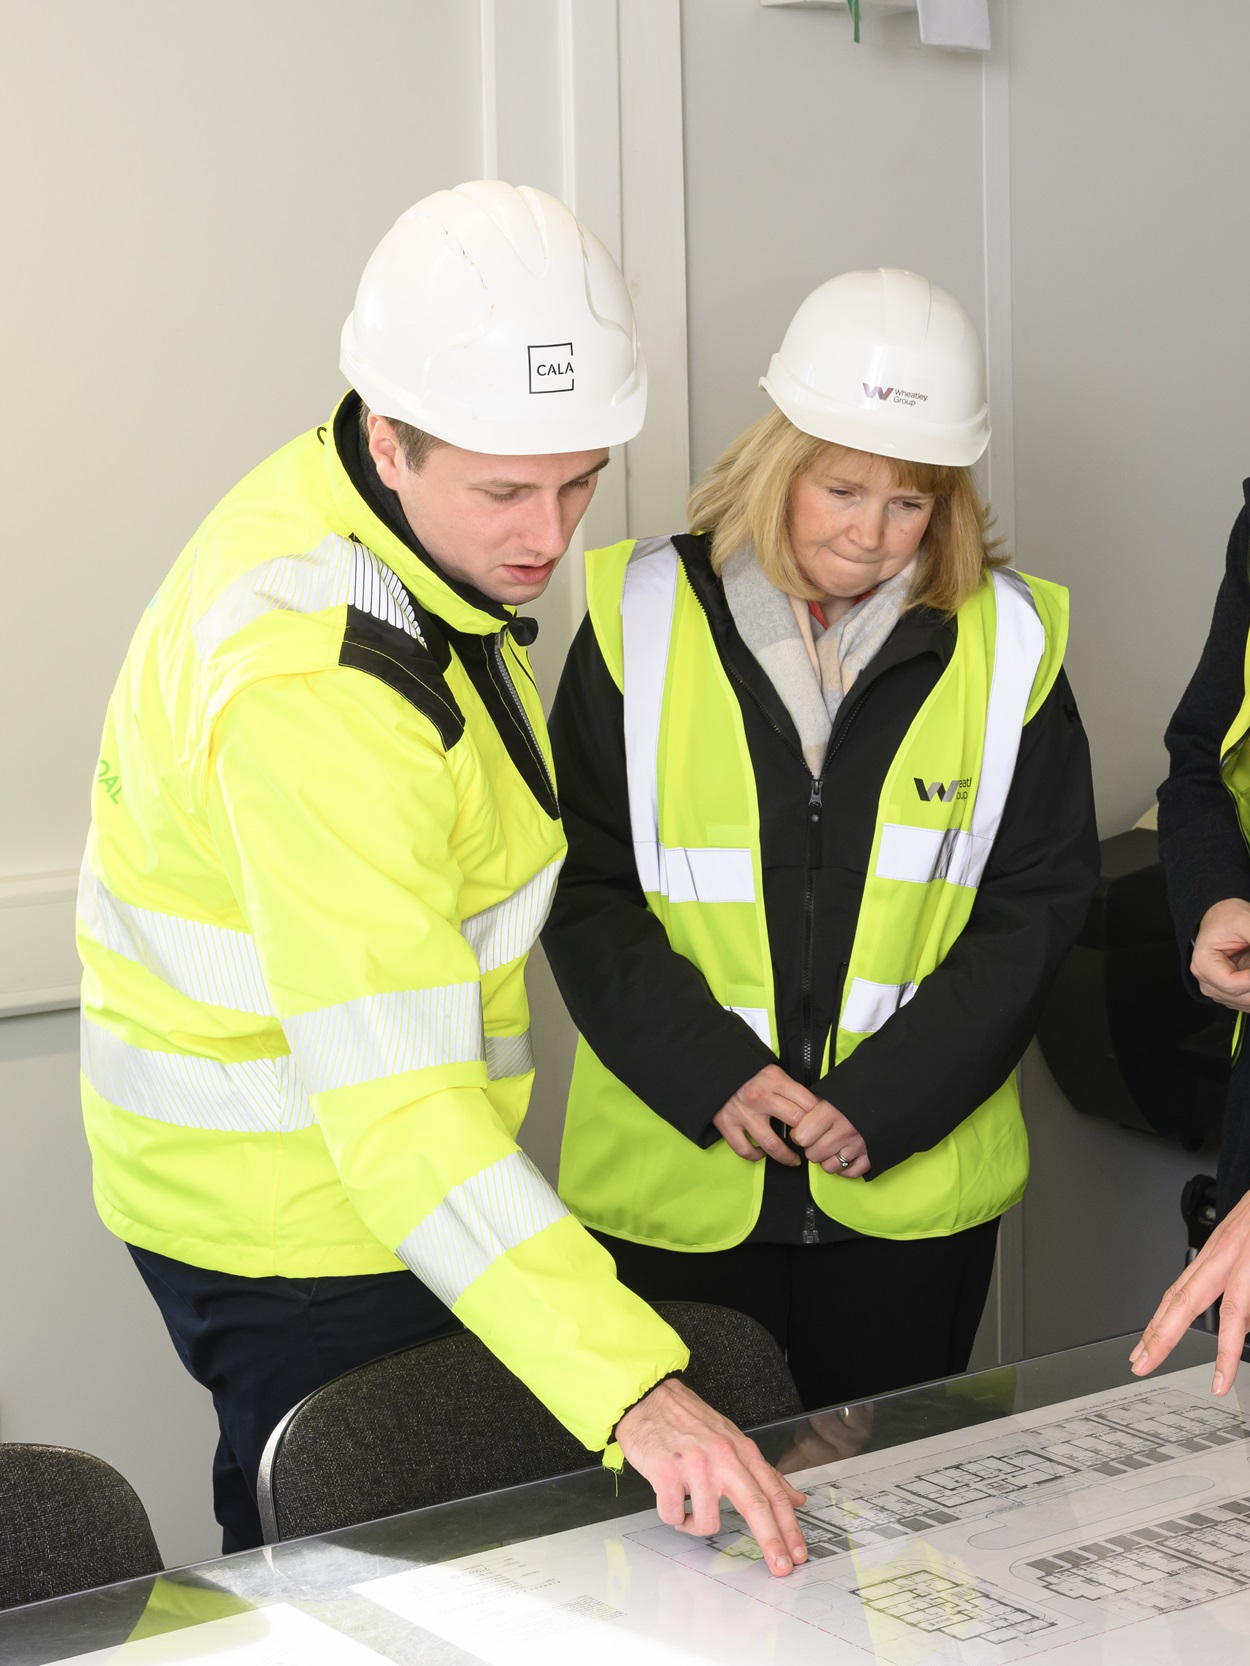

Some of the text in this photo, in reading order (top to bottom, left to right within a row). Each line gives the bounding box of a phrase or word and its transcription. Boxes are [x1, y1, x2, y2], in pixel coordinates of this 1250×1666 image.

[536, 361, 575, 377] CALA
[893, 395, 917, 407] Group
[894, 388, 929, 402] Wheatley
